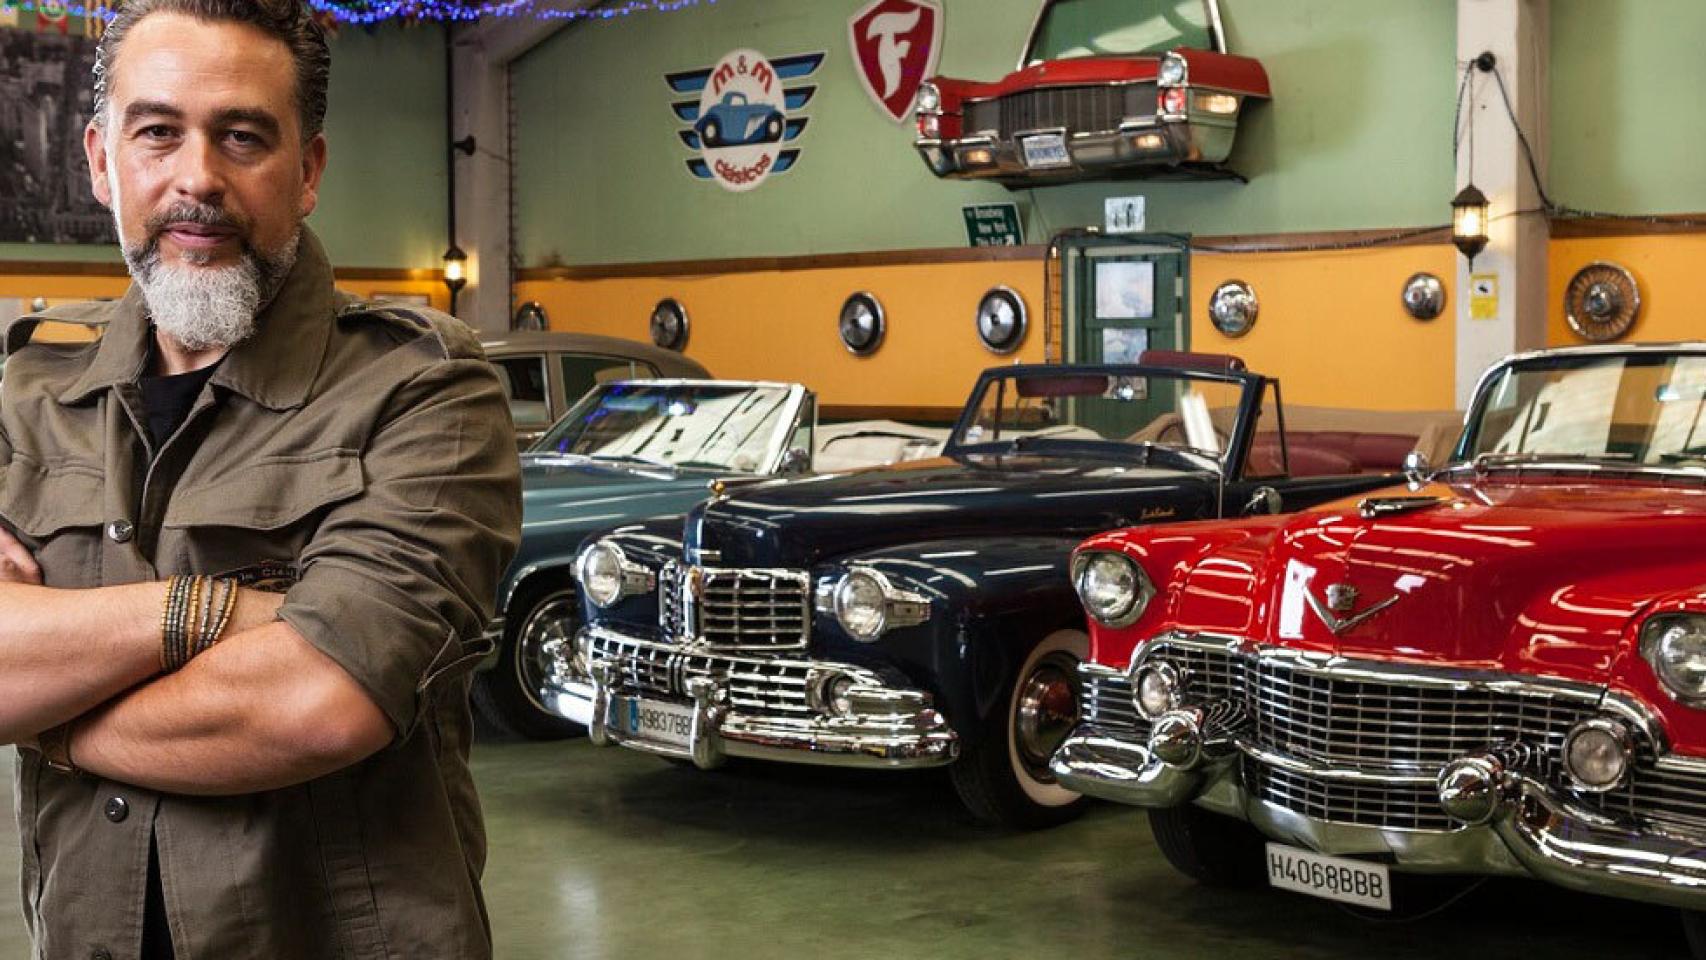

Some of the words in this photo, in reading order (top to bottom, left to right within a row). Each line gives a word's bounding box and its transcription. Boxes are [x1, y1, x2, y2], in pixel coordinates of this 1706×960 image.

[866, 6, 921, 99] F
[638, 708, 693, 736] H9837BB
[1270, 852, 1383, 898] H4068BBB
